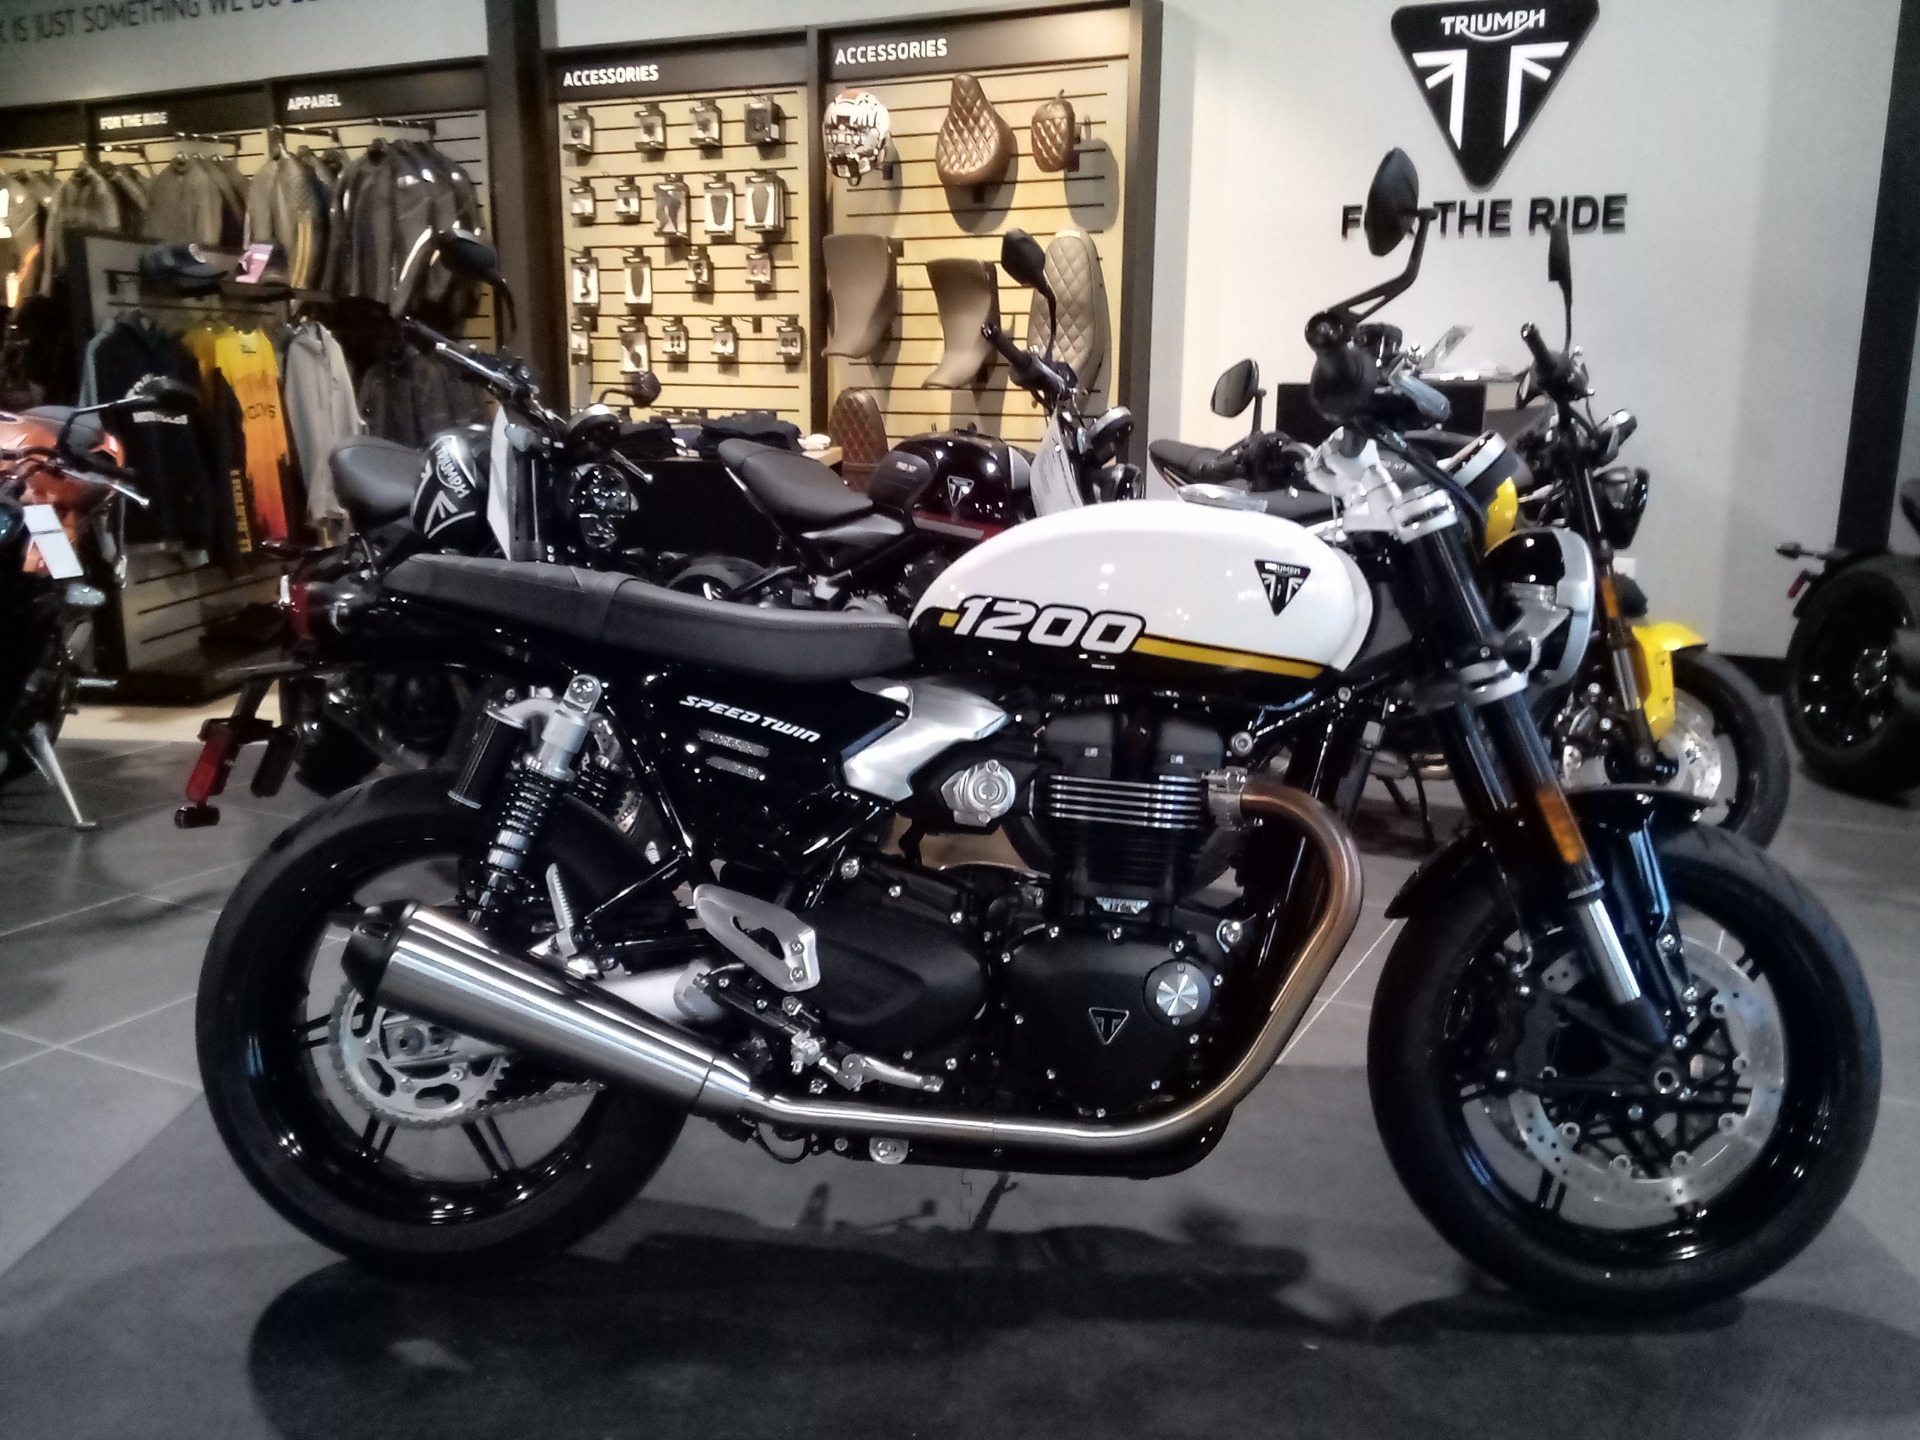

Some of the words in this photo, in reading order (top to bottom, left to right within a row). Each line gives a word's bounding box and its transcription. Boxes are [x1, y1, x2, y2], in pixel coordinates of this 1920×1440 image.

[34, 8, 76, 42] JUST
[82, 0, 201, 33] SOMETHING
[1440, 8, 1546, 41] TRIUMPH
[835, 38, 948, 66] ACCESSORIES
[562, 64, 660, 88] ACCESSORIES
[287, 93, 342, 112] APPAREL
[1433, 198, 1512, 239] THE
[954, 596, 1144, 654] 1200
[679, 695, 761, 724] SPEED
[760, 716, 821, 743] TWIN
